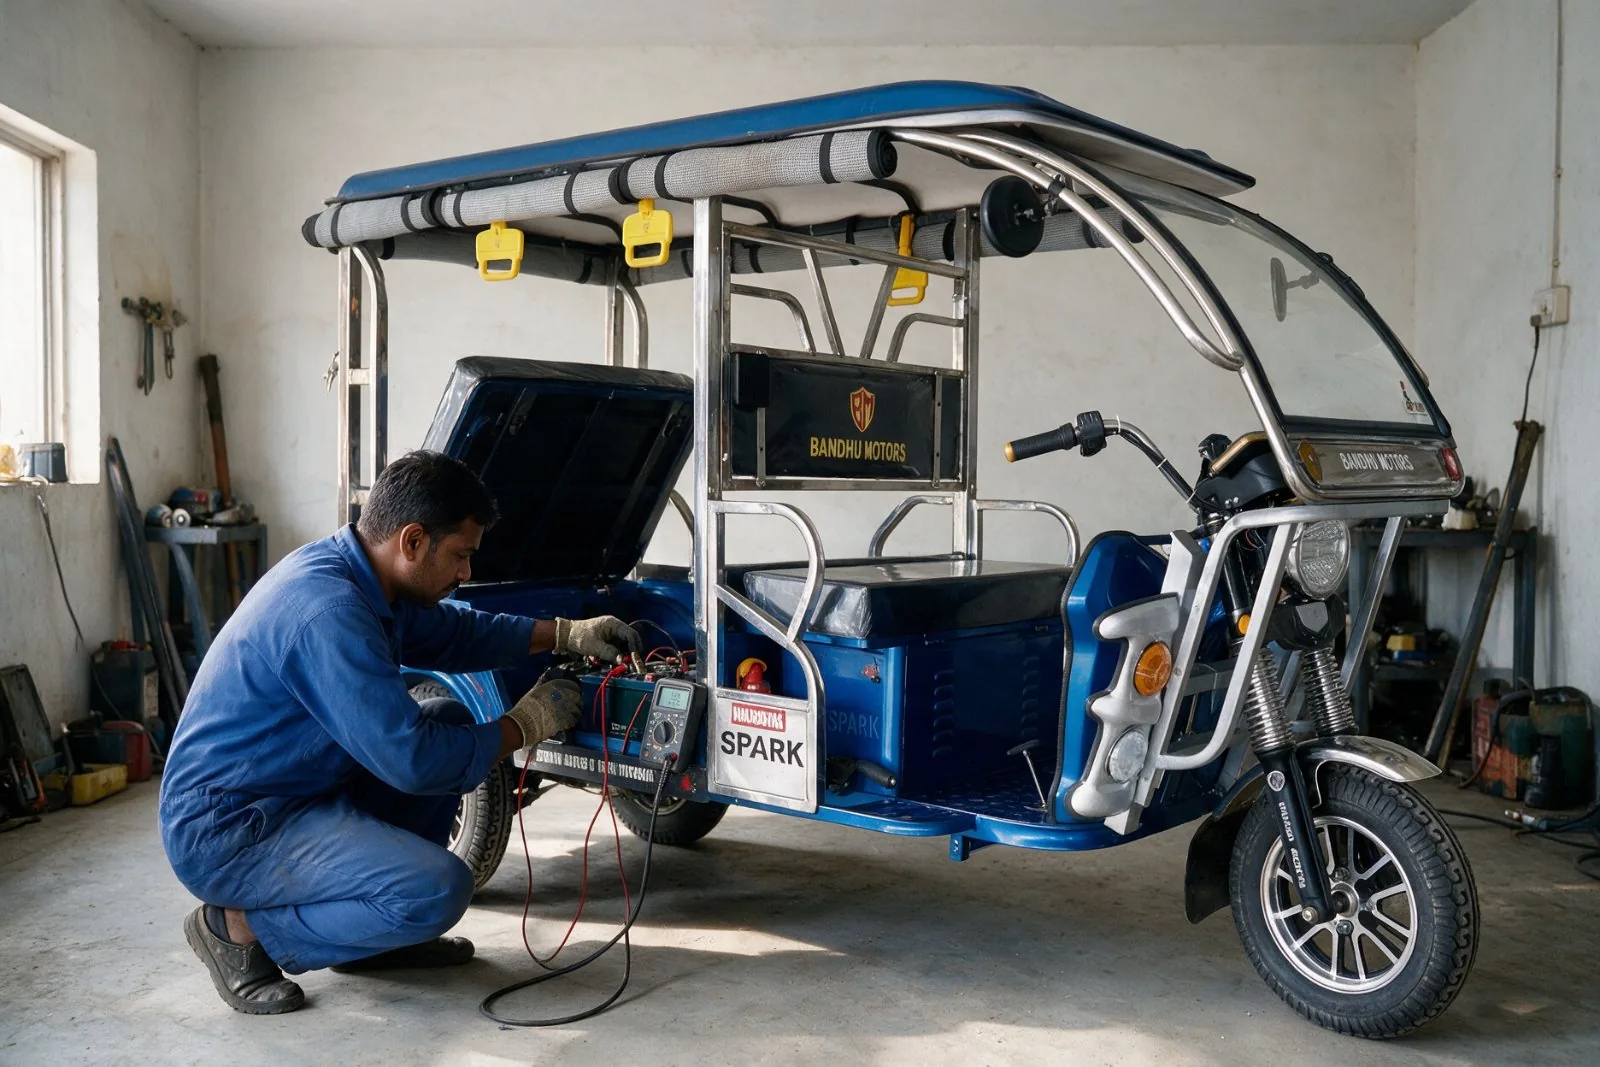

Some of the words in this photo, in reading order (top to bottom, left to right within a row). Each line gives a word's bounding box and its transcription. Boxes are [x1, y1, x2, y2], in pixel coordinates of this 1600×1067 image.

[810, 436, 862, 459] BANDHU
[864, 440, 906, 462] MOTORS
[828, 709, 880, 739] SPARK
[720, 730, 804, 768] SPARK
